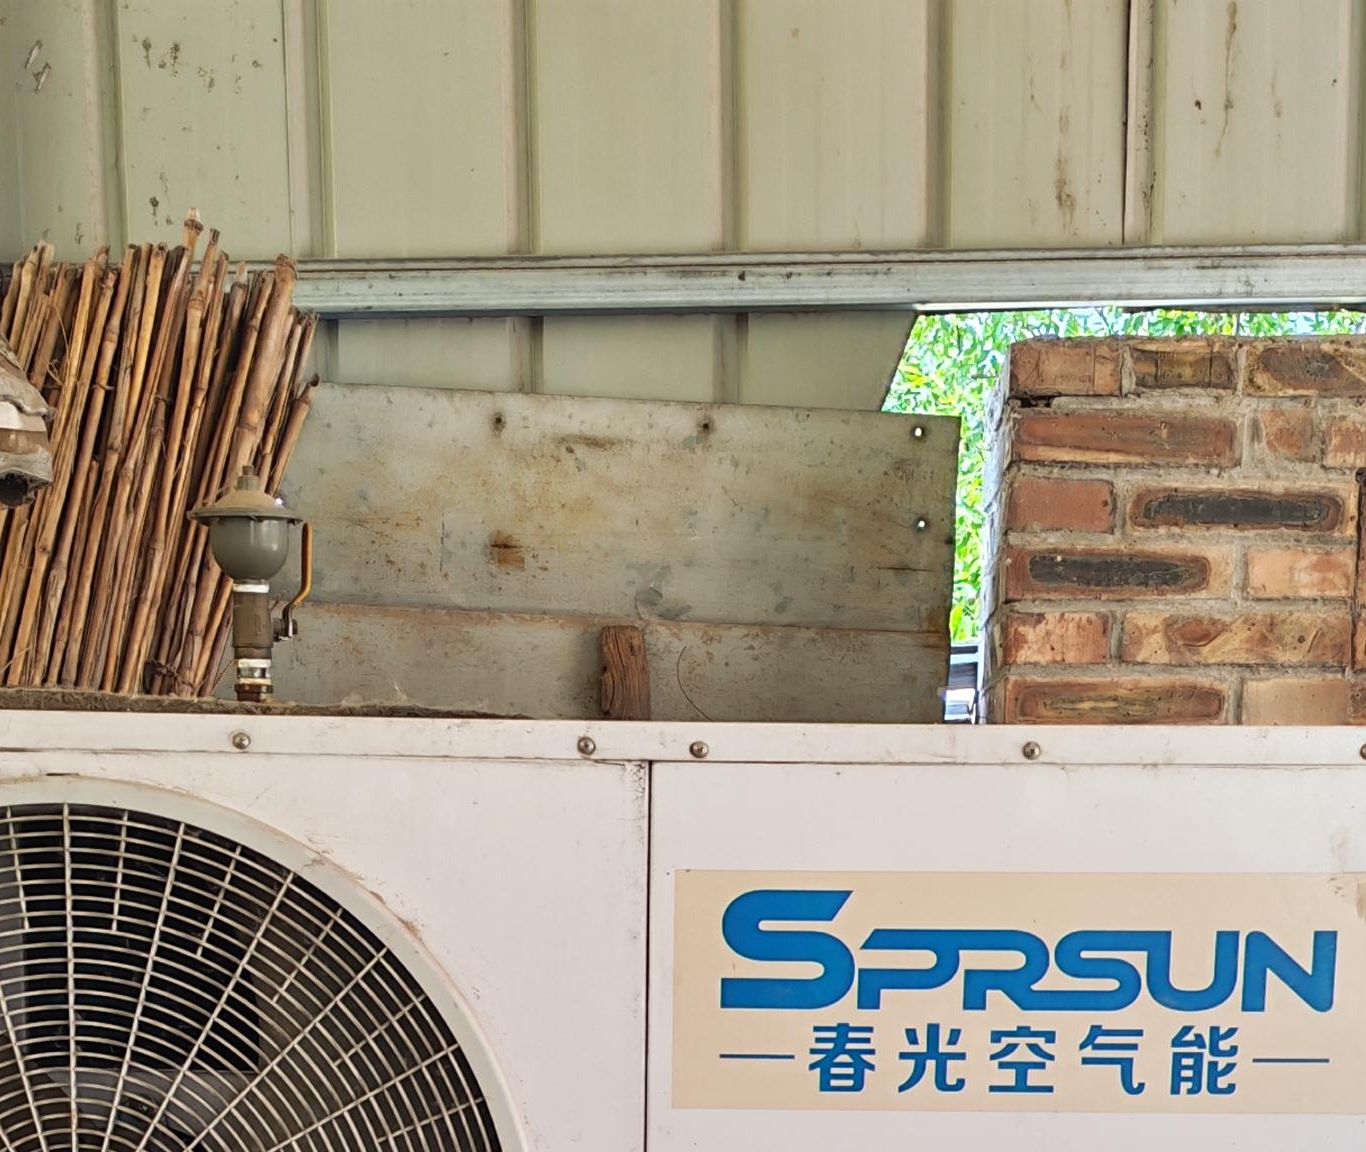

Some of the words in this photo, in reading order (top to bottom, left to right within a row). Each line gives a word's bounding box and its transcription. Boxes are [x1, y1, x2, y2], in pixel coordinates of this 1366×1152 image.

[720, 889, 1338, 1013] SPRSUN
[808, 1022, 1240, 1096] 春光空气能
